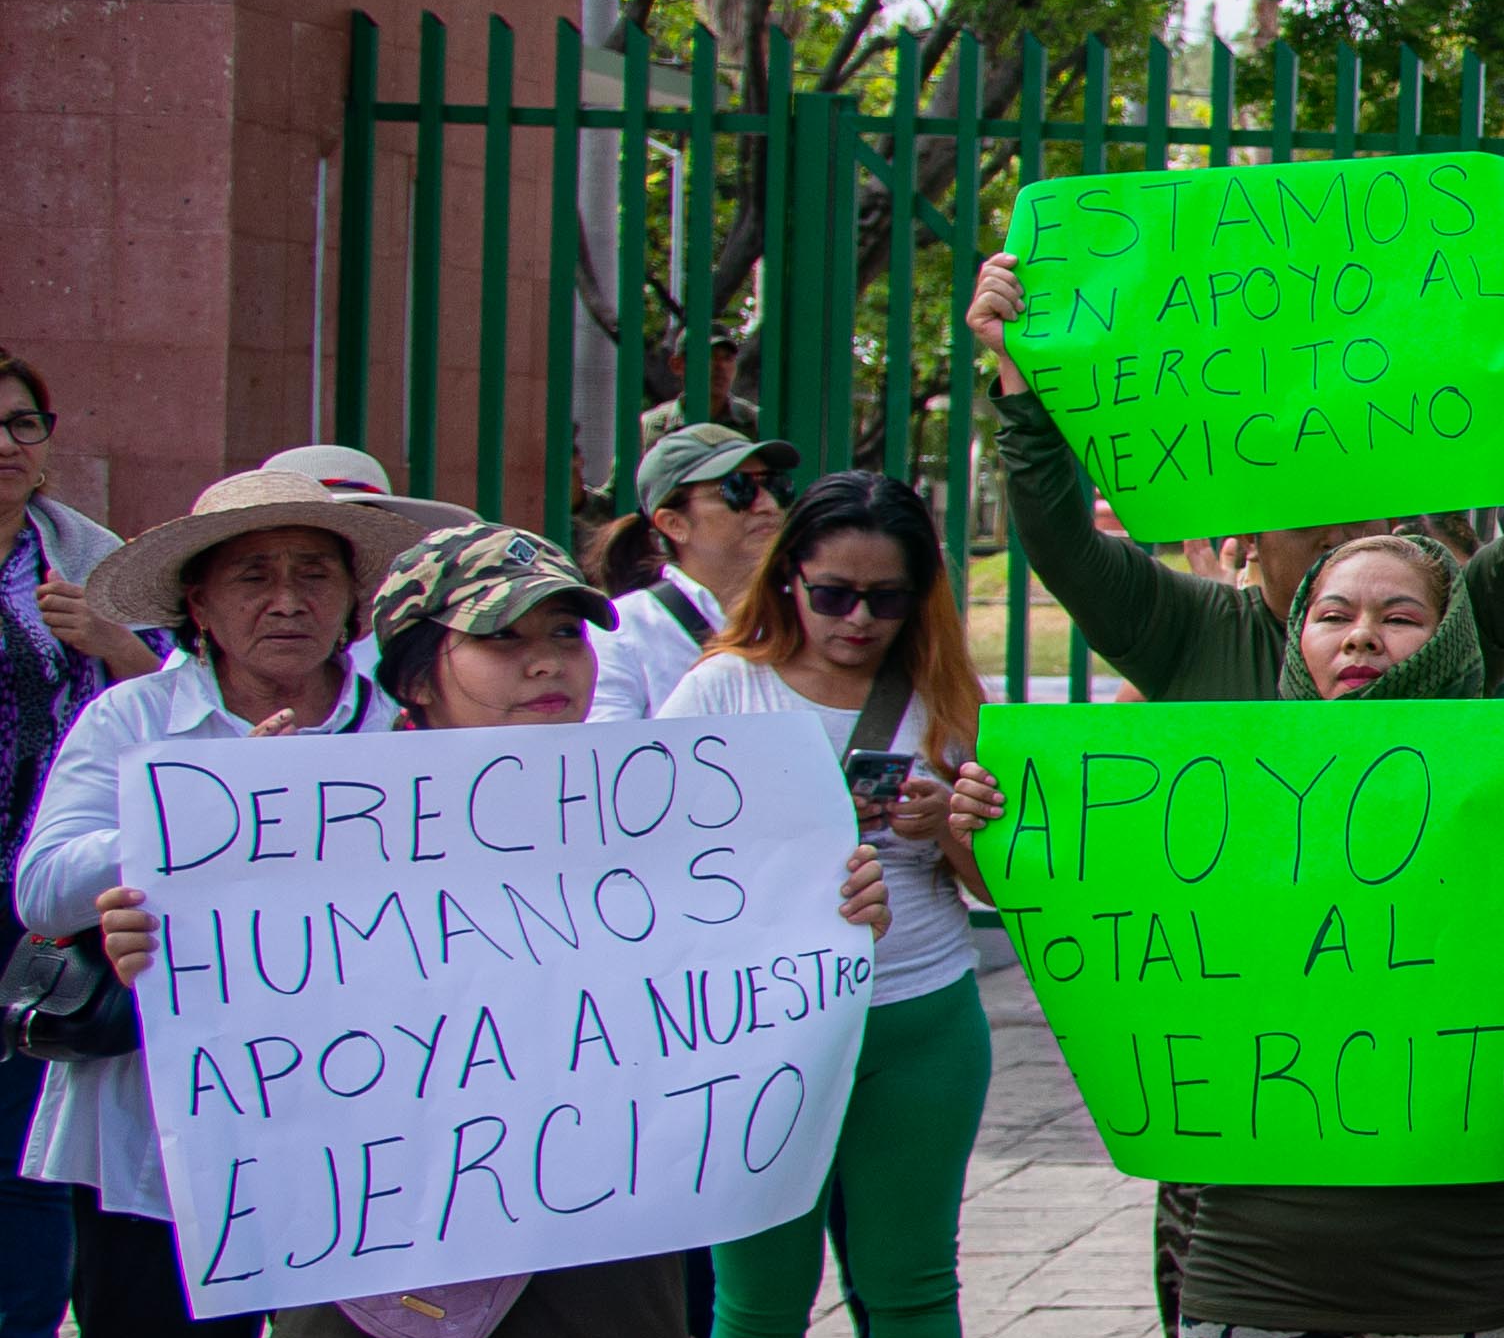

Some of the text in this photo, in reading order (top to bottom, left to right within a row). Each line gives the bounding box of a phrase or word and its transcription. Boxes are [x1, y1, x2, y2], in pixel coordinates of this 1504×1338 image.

[1026, 163, 1476, 264] ESTAMOS
[1022, 285, 1117, 338] EN
[1157, 261, 1375, 327] APOYO
[1033, 337, 1390, 414] EJERCITO
[147, 734, 743, 876] DERECHOS
[1005, 745, 1432, 886] APOYO
[160, 846, 746, 1016] HUMANOS
[1304, 903, 1435, 977] AL
[188, 947, 873, 1119] APOYA A NUESTRO
[201, 1062, 806, 1287] EJERCITO
